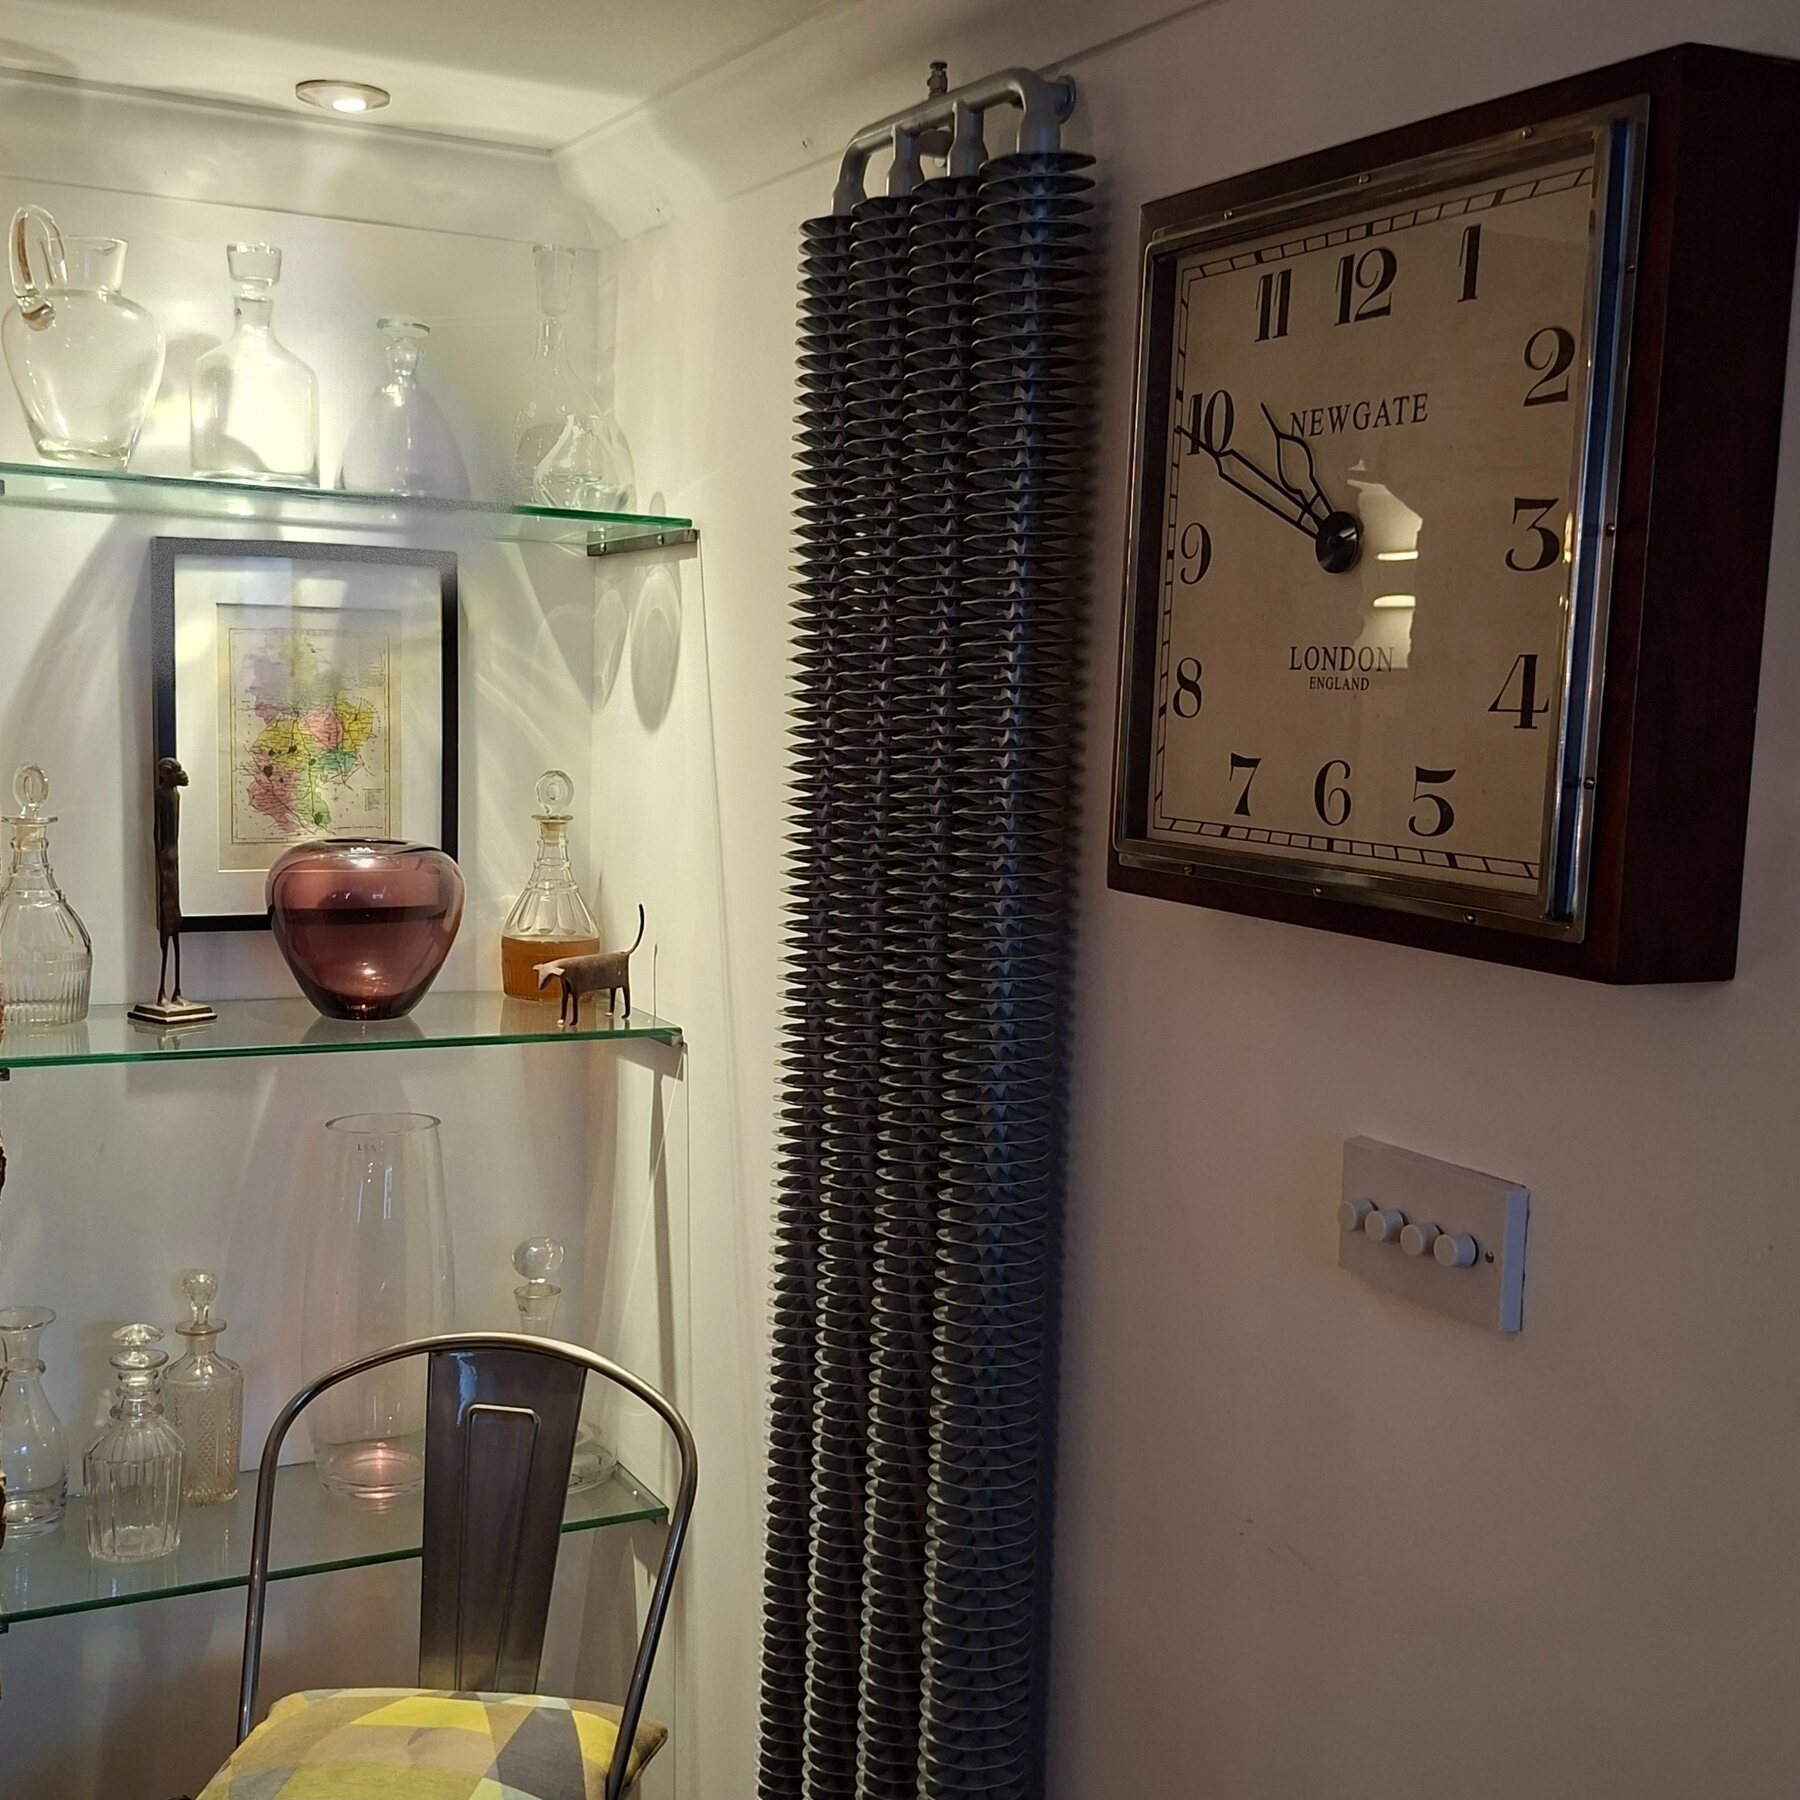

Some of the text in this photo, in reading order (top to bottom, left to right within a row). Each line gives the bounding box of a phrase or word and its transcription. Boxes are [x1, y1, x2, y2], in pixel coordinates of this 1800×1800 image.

[1334, 247, 1398, 327] 12
[1457, 223, 1482, 303] 1
[1254, 269, 1293, 343] 11
[1523, 326, 1576, 407] 2
[1186, 389, 1235, 456] 10
[1289, 393, 1428, 438] NEWGATE
[1180, 522, 1212, 585] 9
[1505, 497, 1560, 572] 3
[1172, 657, 1202, 719] 8
[1288, 646, 1395, 673] LONDON
[1308, 676, 1371, 691] ENGLAND
[1488, 654, 1550, 730] 4
[1229, 752, 1262, 817] 7
[1314, 759, 1352, 826] 6
[1408, 765, 1457, 837] 5
